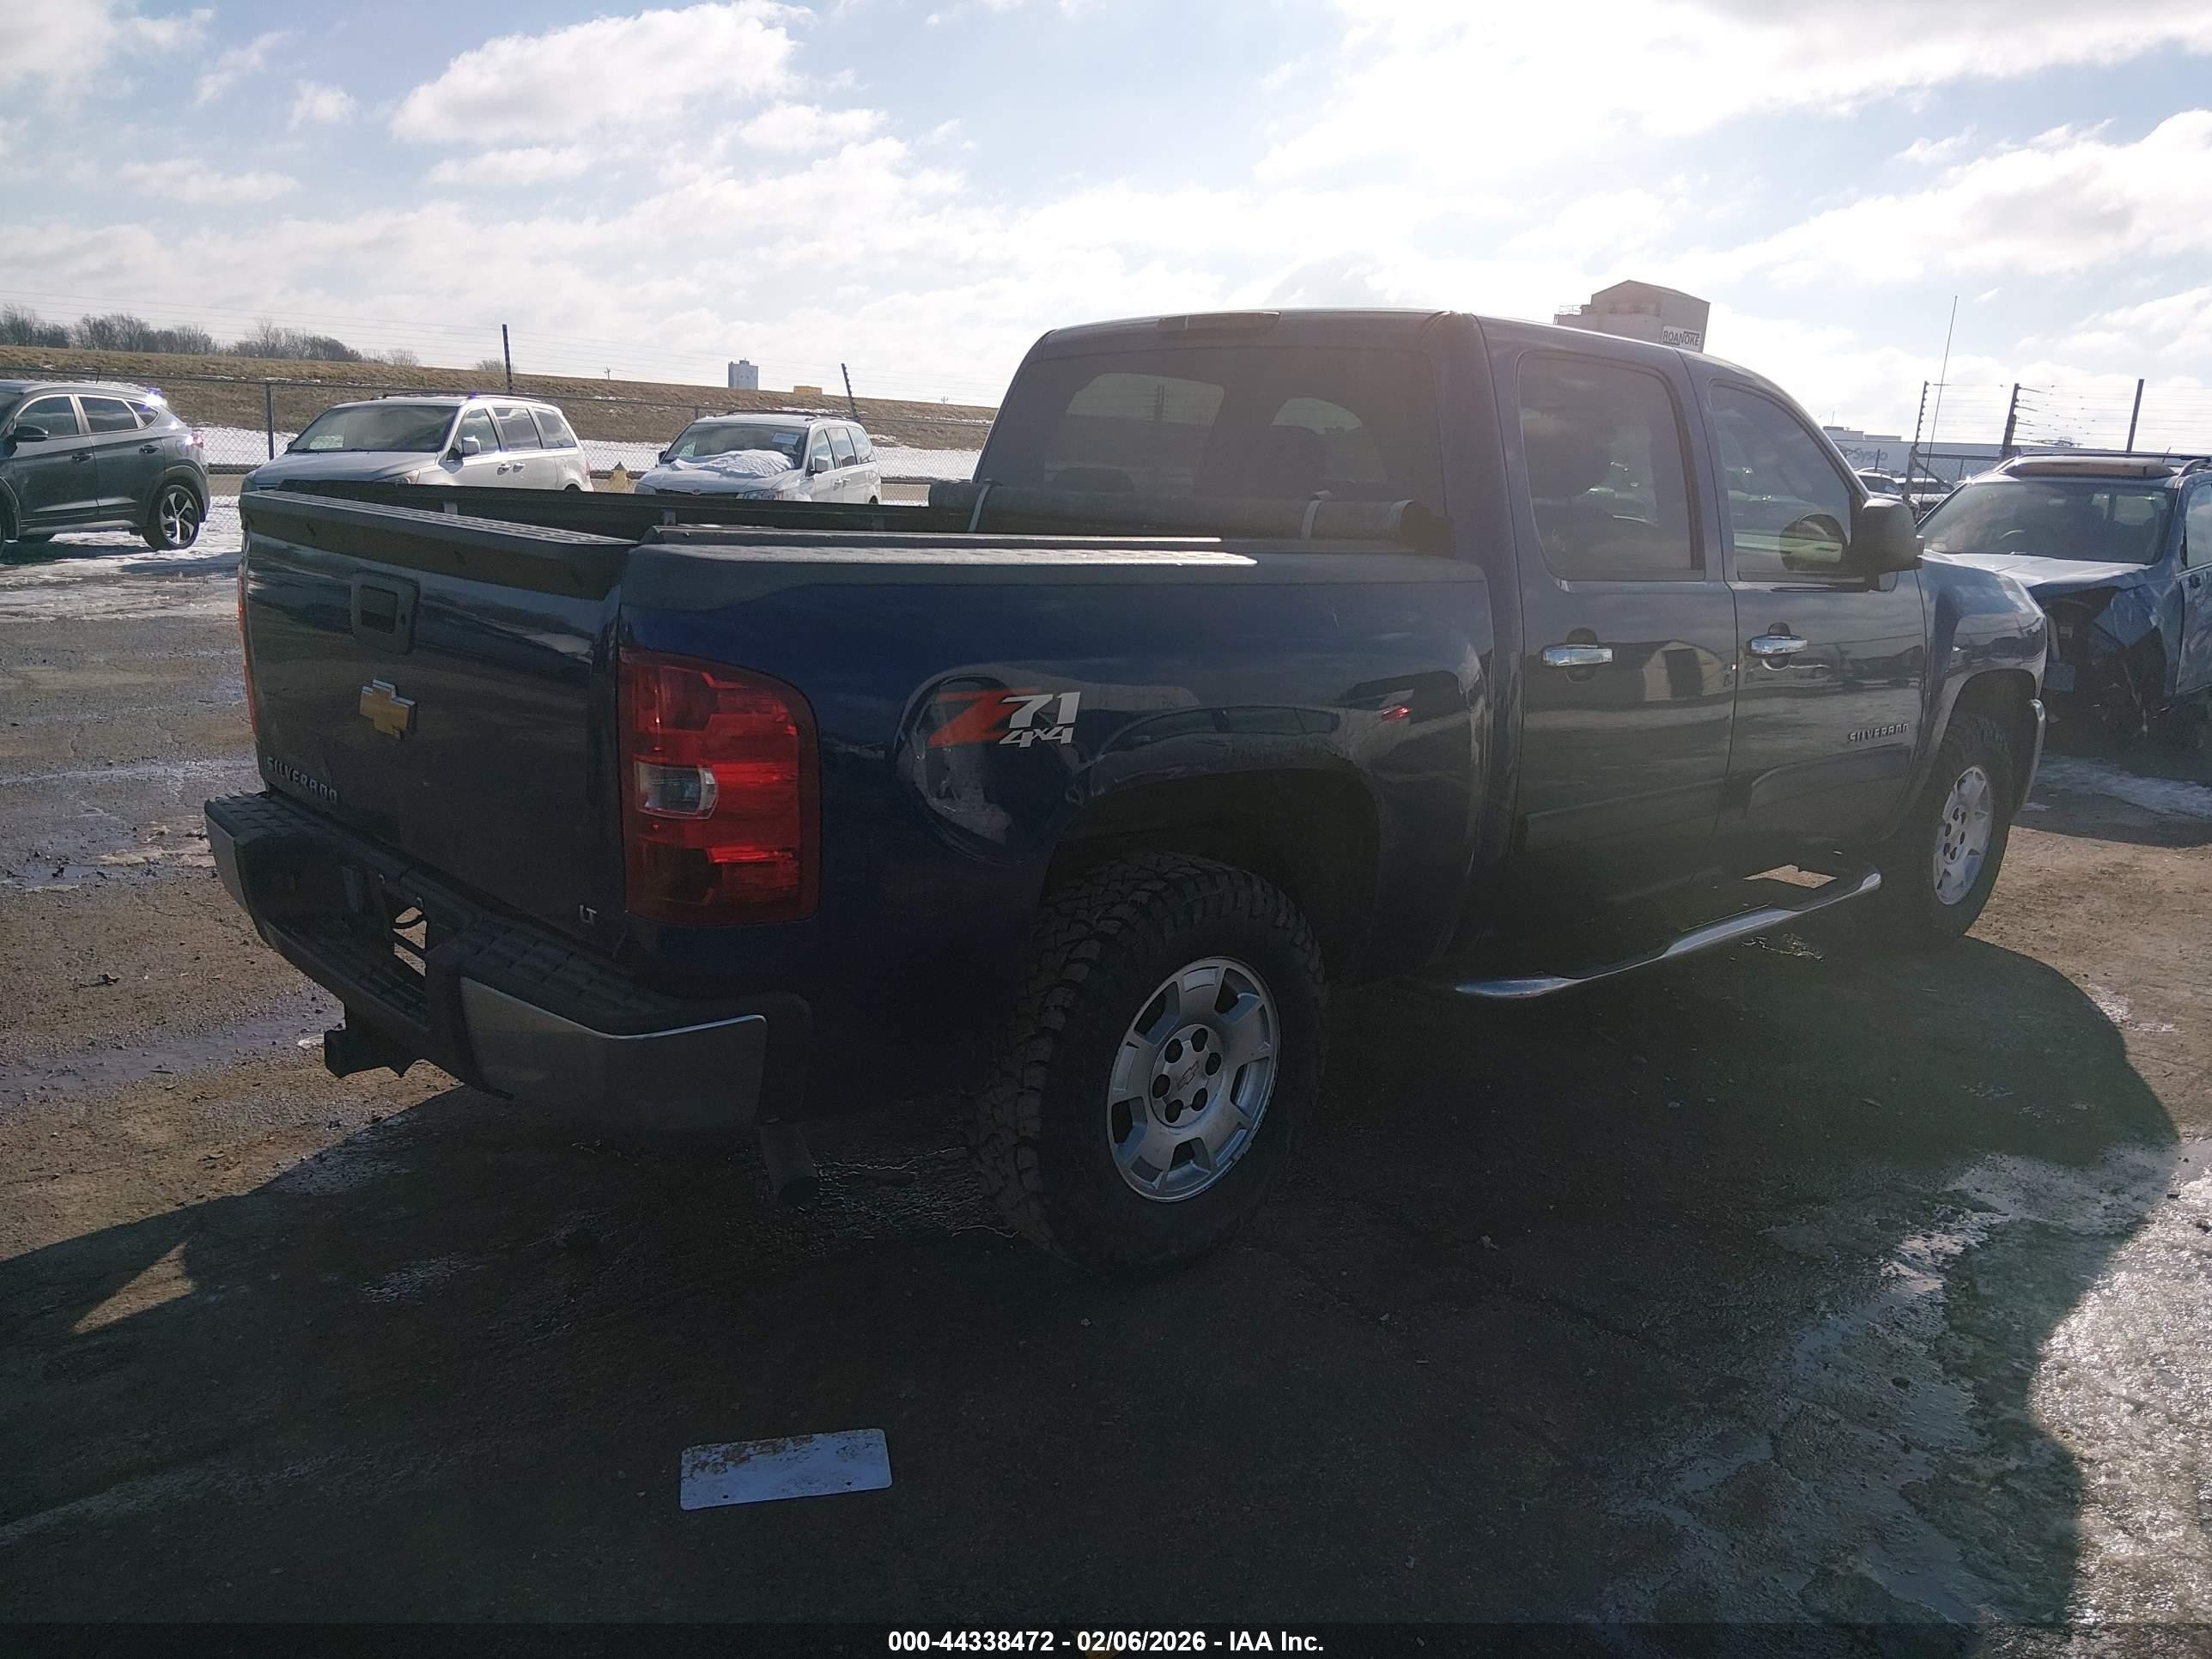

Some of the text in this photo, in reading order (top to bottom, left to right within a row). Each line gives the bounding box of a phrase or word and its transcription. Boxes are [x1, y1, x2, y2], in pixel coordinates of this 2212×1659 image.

[1662, 330, 1700, 346] ROANOKE
[267, 756, 337, 805] SILVERADO
[579, 904, 598, 927] LT
